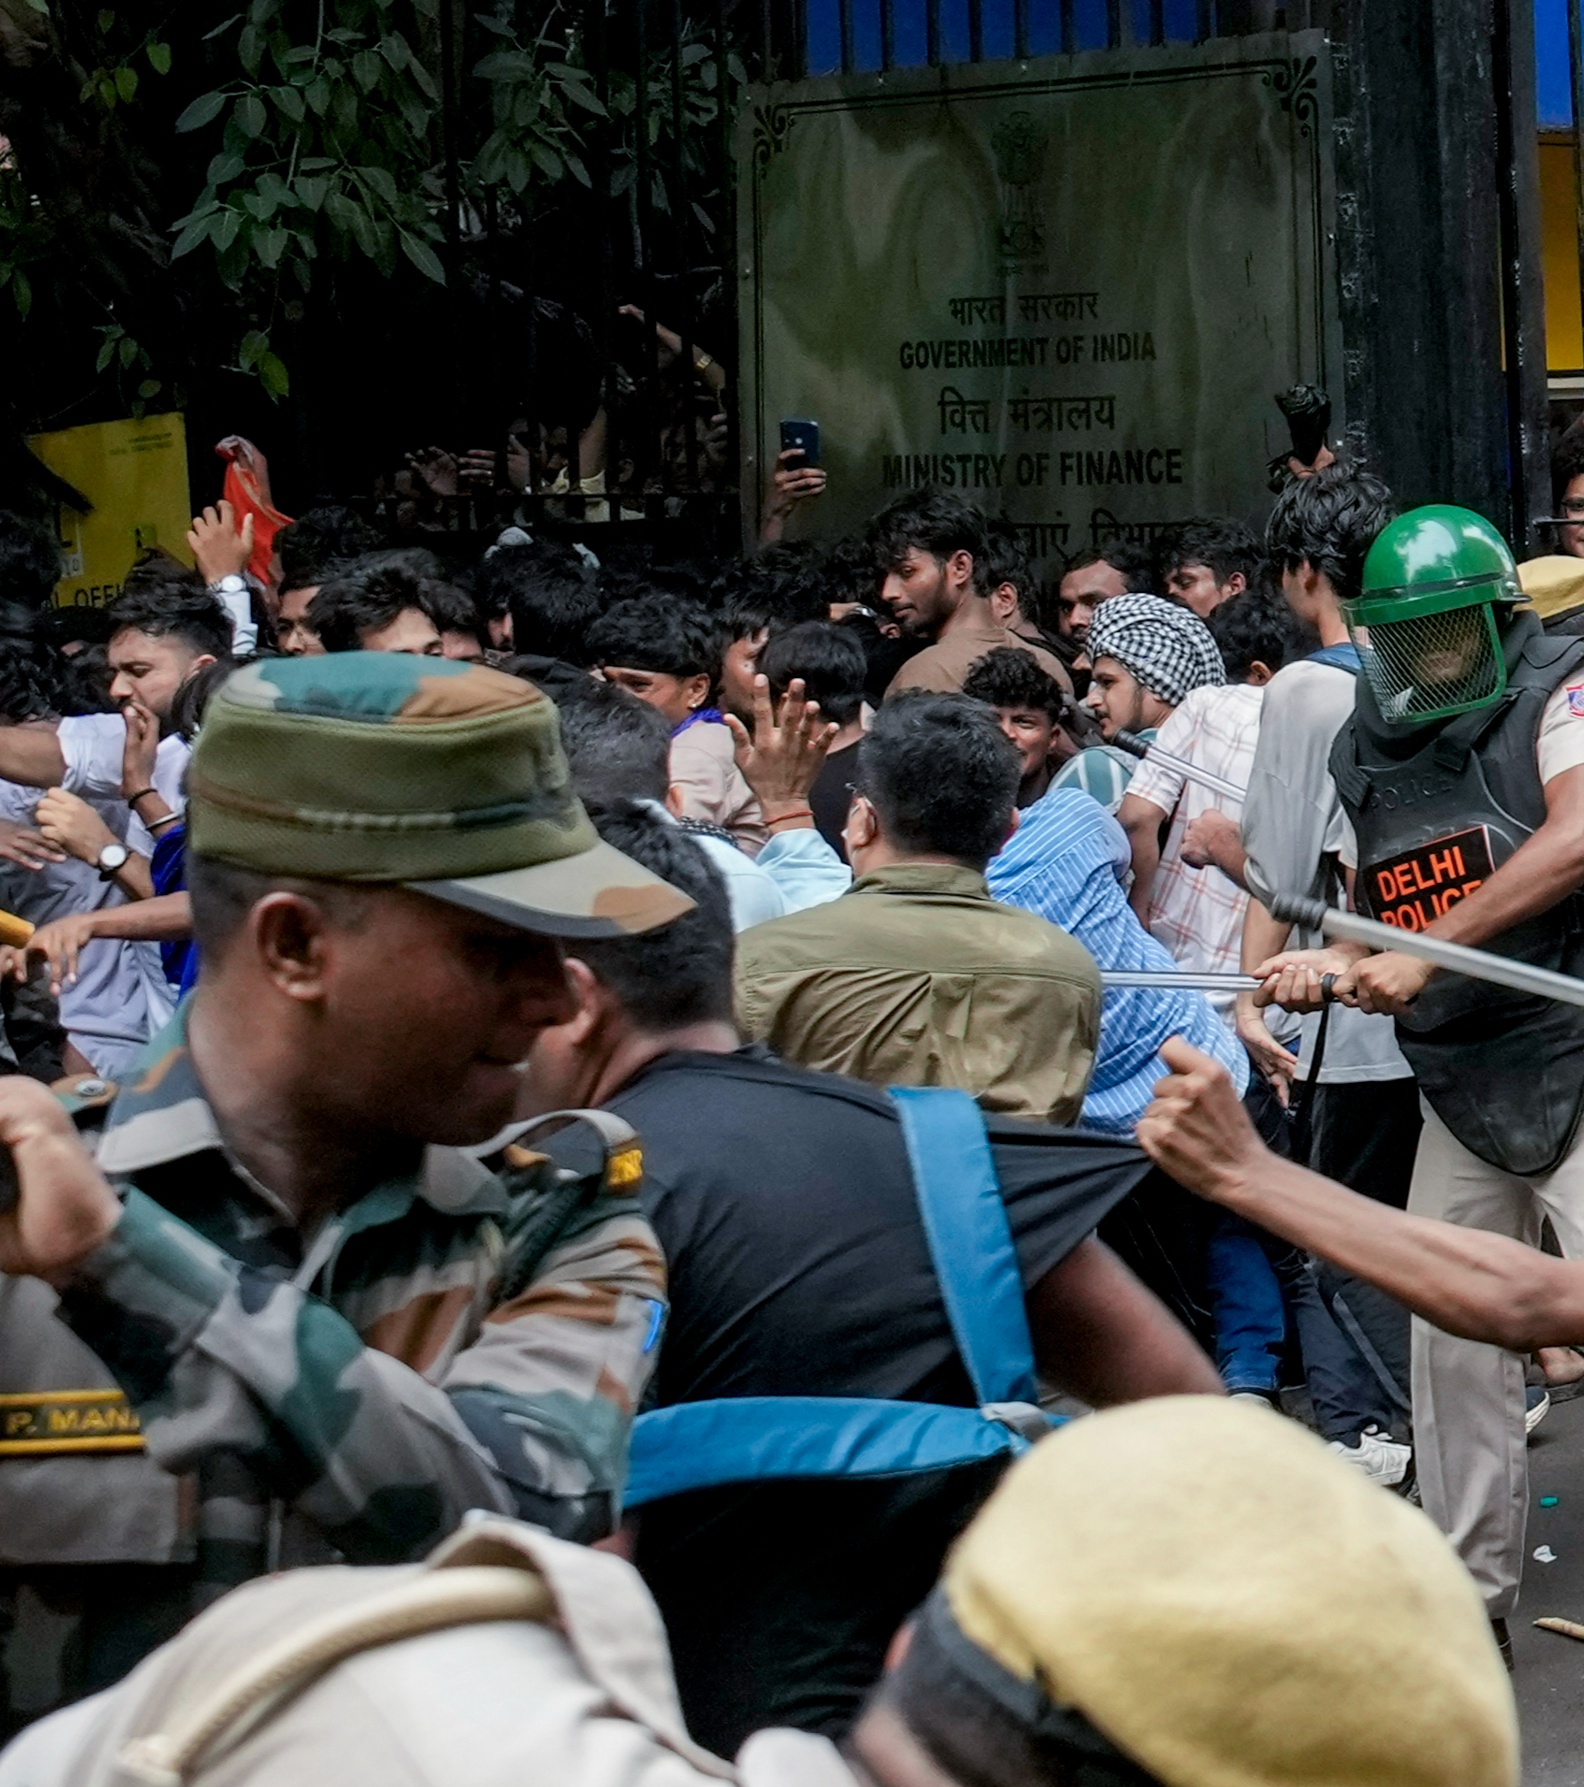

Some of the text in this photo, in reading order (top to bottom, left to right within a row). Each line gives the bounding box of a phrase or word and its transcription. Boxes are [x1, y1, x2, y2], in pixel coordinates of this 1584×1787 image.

[949, 292, 1099, 326] भारत सरकार
[899, 331, 1157, 369] GOVERNMENT OF INDIA
[938, 386, 1116, 435] वित्त मंत्रालय
[882, 448, 1183, 488] MINISTRY OF FINANCE
[1376, 845, 1467, 903] DELHI
